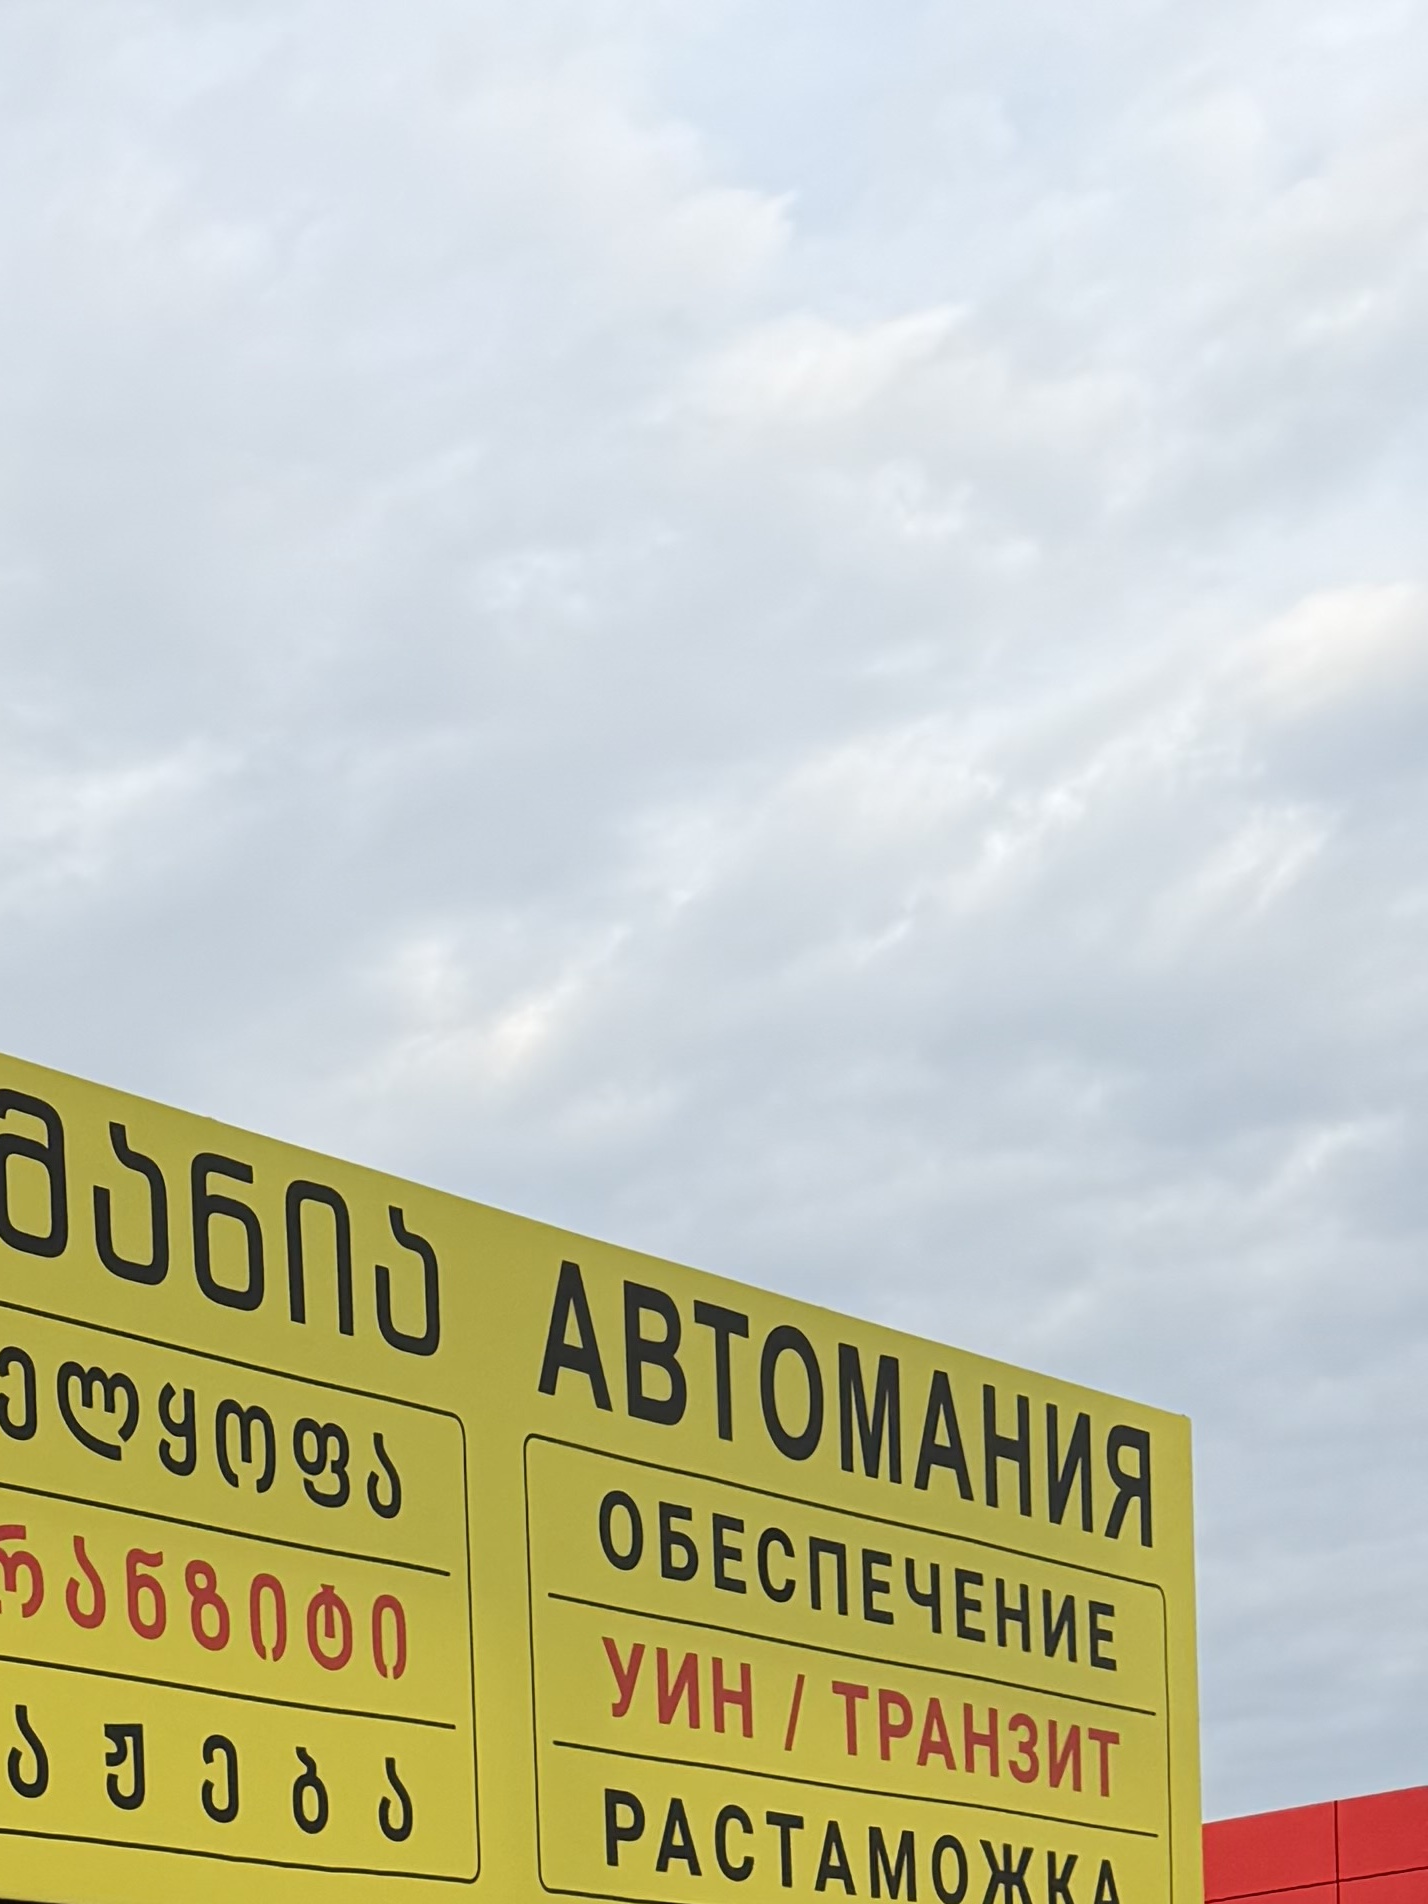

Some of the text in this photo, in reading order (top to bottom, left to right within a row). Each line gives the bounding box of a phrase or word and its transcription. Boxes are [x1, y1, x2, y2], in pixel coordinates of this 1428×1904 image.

[537, 1259, 1154, 1548] АВТОМАНИЯ
[598, 1490, 1118, 1672] ОБЕСПЕЧЕНИЕ
[602, 1636, 754, 1739] УИН
[831, 1680, 1121, 1798] ТРАНЗИТ
